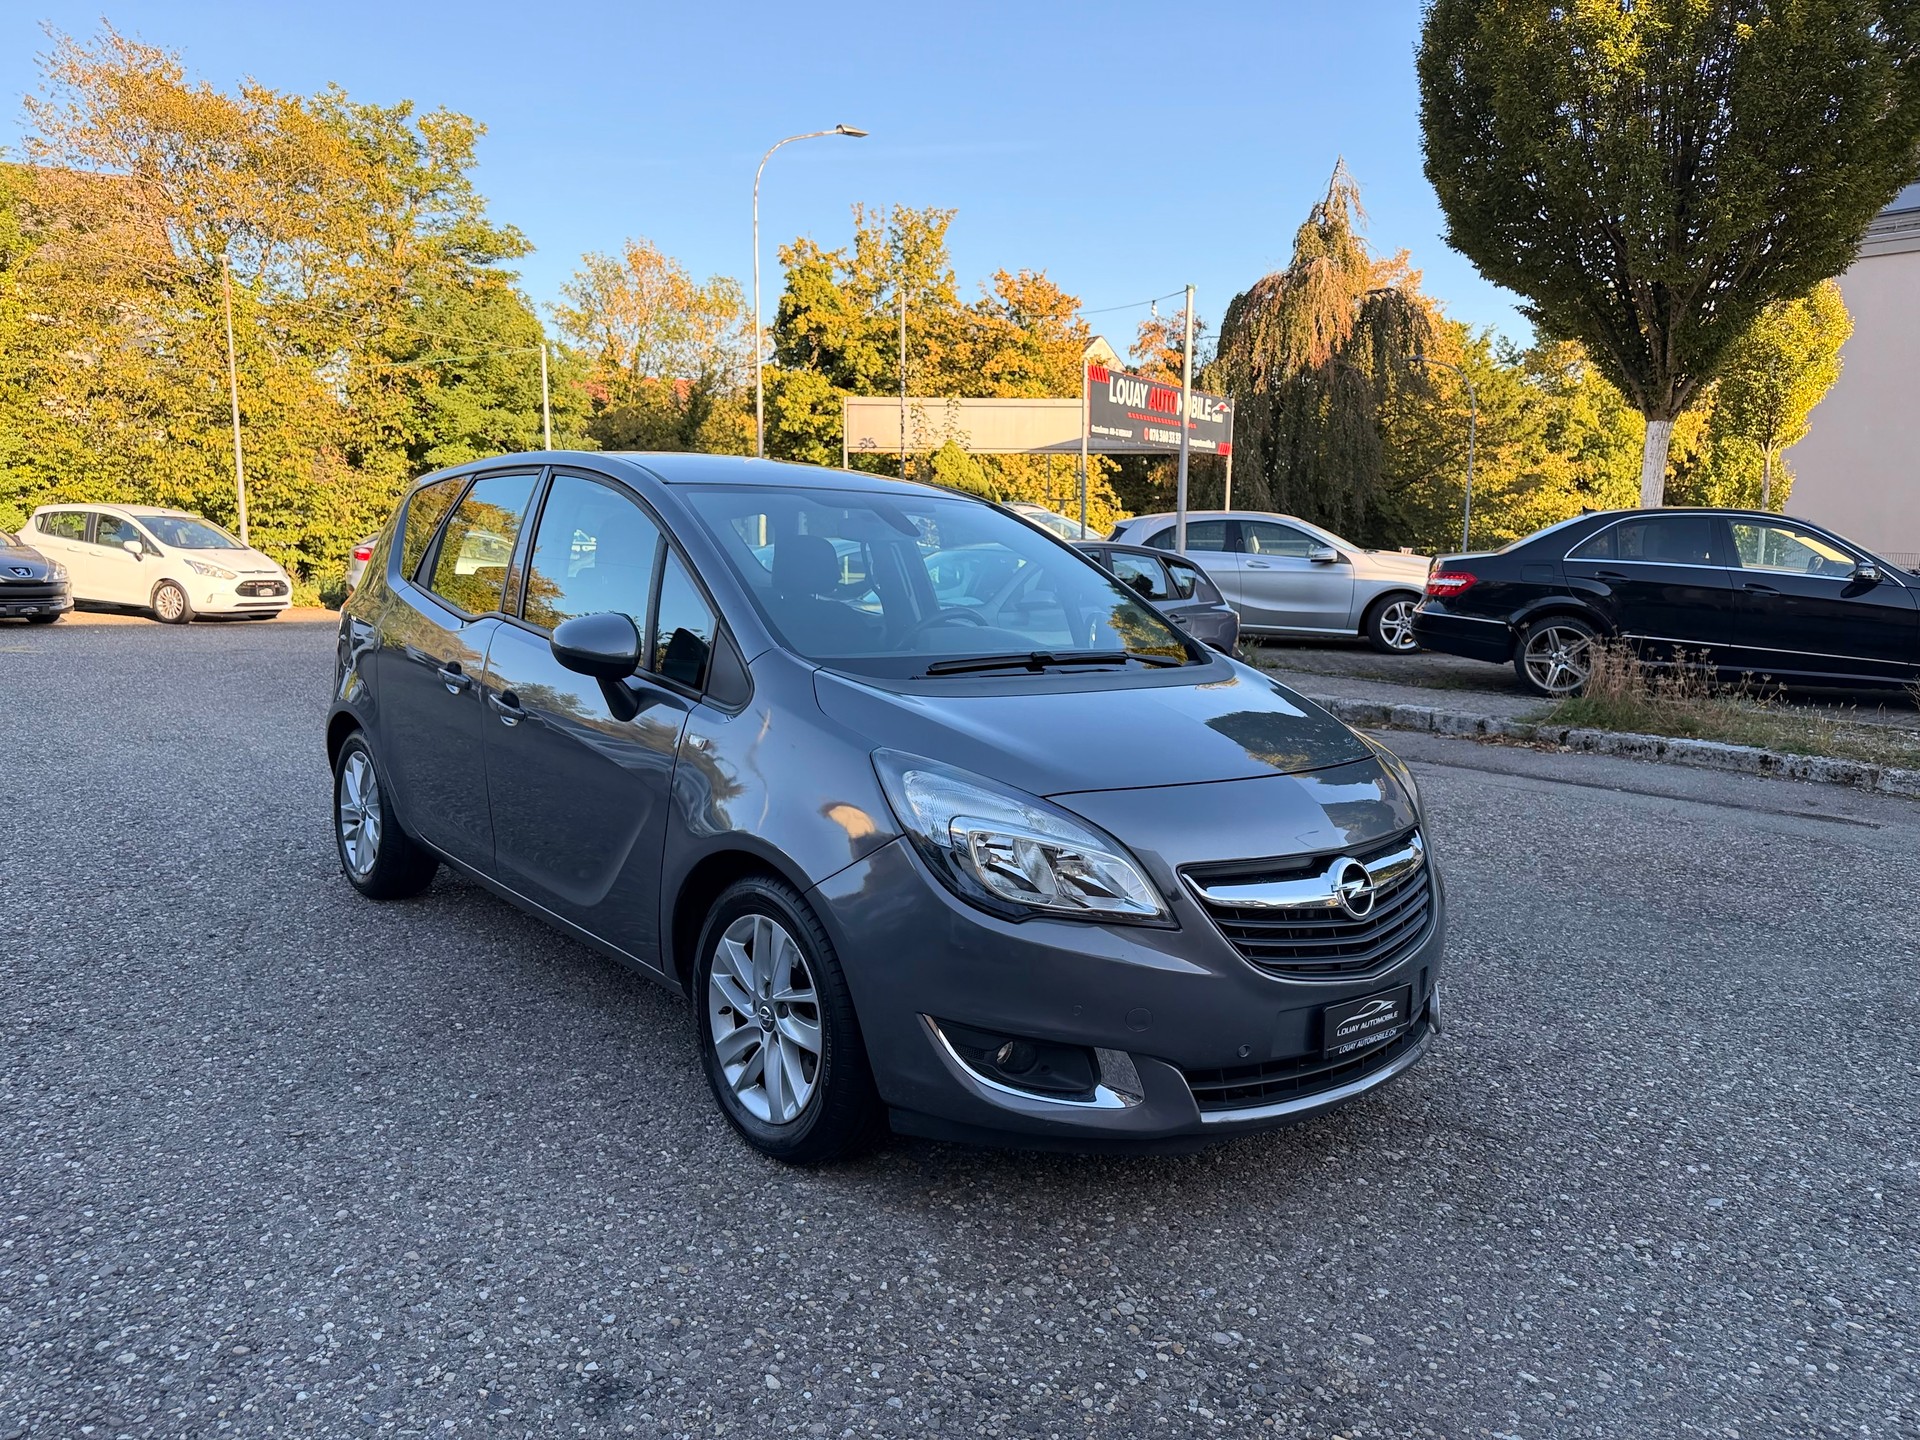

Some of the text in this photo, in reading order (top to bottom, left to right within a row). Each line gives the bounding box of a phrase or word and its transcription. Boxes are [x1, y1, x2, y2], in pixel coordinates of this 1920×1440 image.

[1109, 376, 1212, 421] LOUAY AUTOMBILE
[1336, 1010, 1399, 1037] LOUAY AUTOMOBILE
[1339, 1029, 1397, 1054] LOUAY AUTOMOBILE.CH
